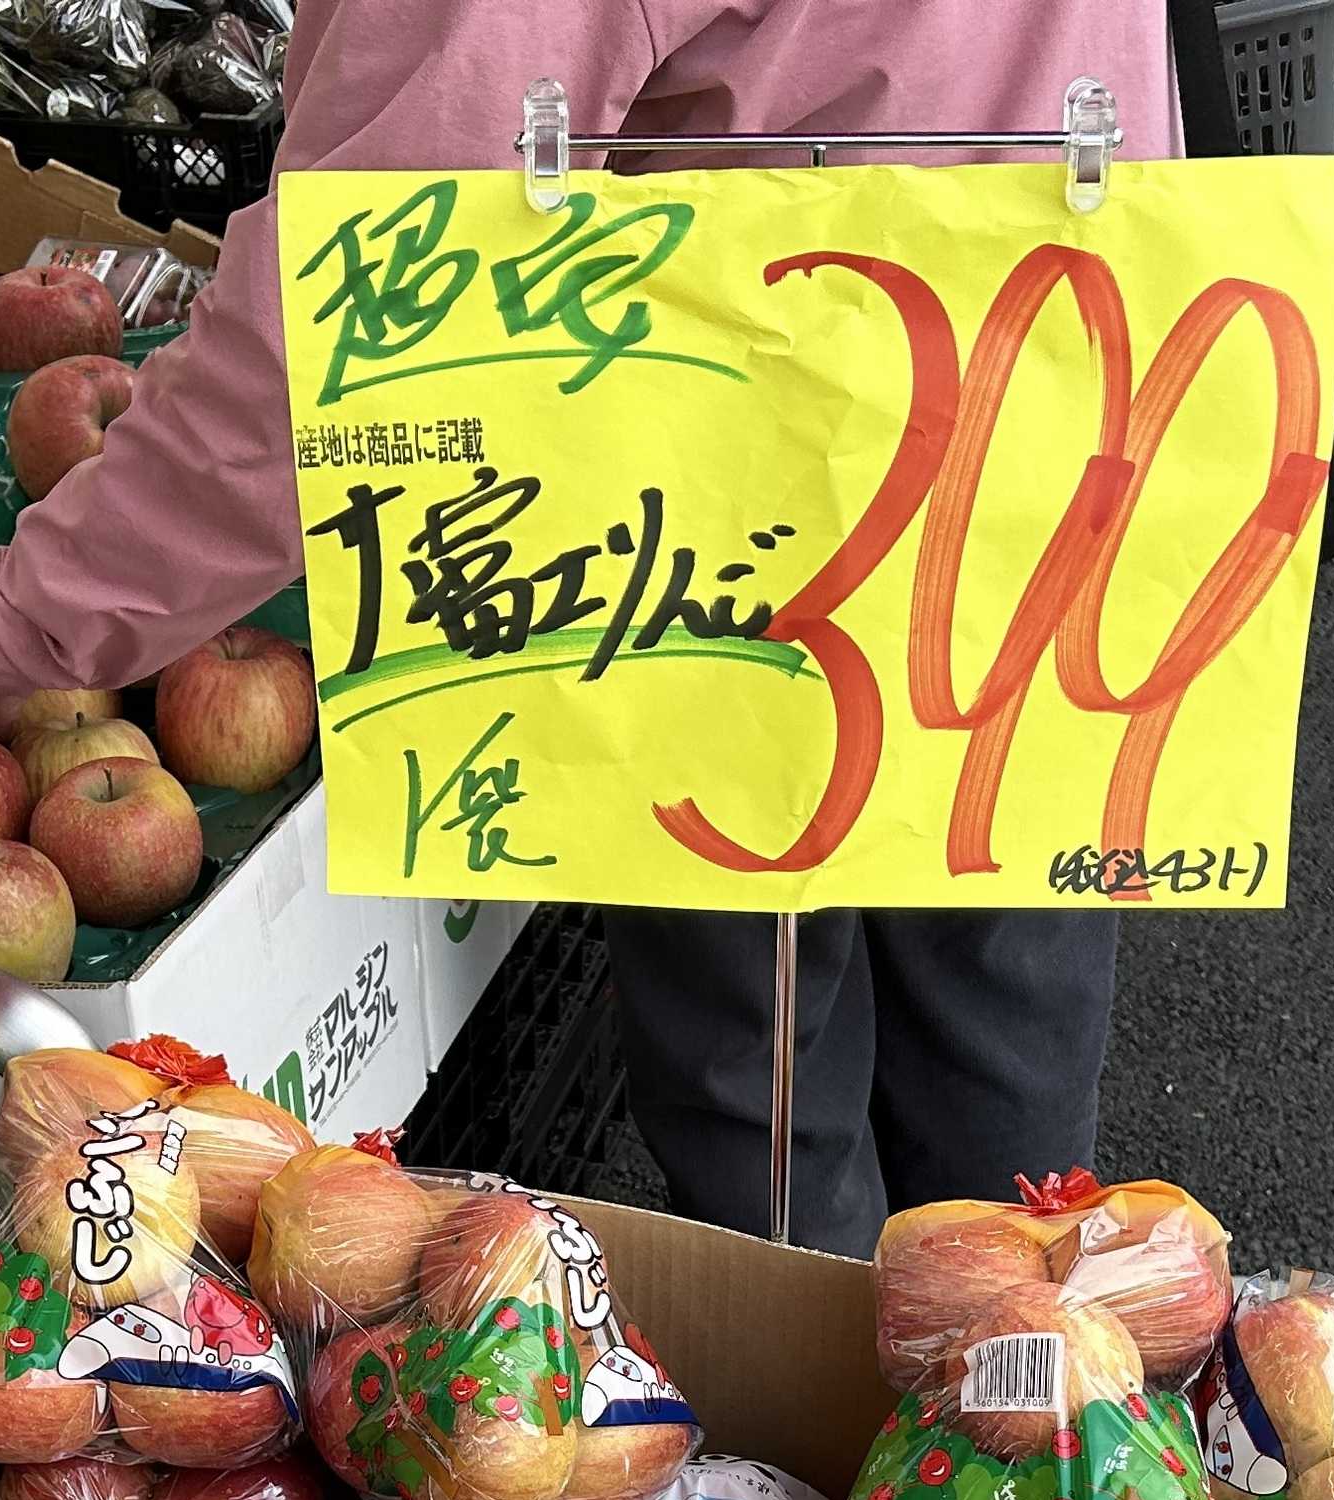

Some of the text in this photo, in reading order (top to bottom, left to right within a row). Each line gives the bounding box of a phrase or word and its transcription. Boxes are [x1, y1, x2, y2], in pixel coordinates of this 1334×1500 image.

[295, 416, 486, 470] 産地は商品に記載
[652, 242, 1330, 901] 399
[308, 984, 399, 1122] サンアップル
